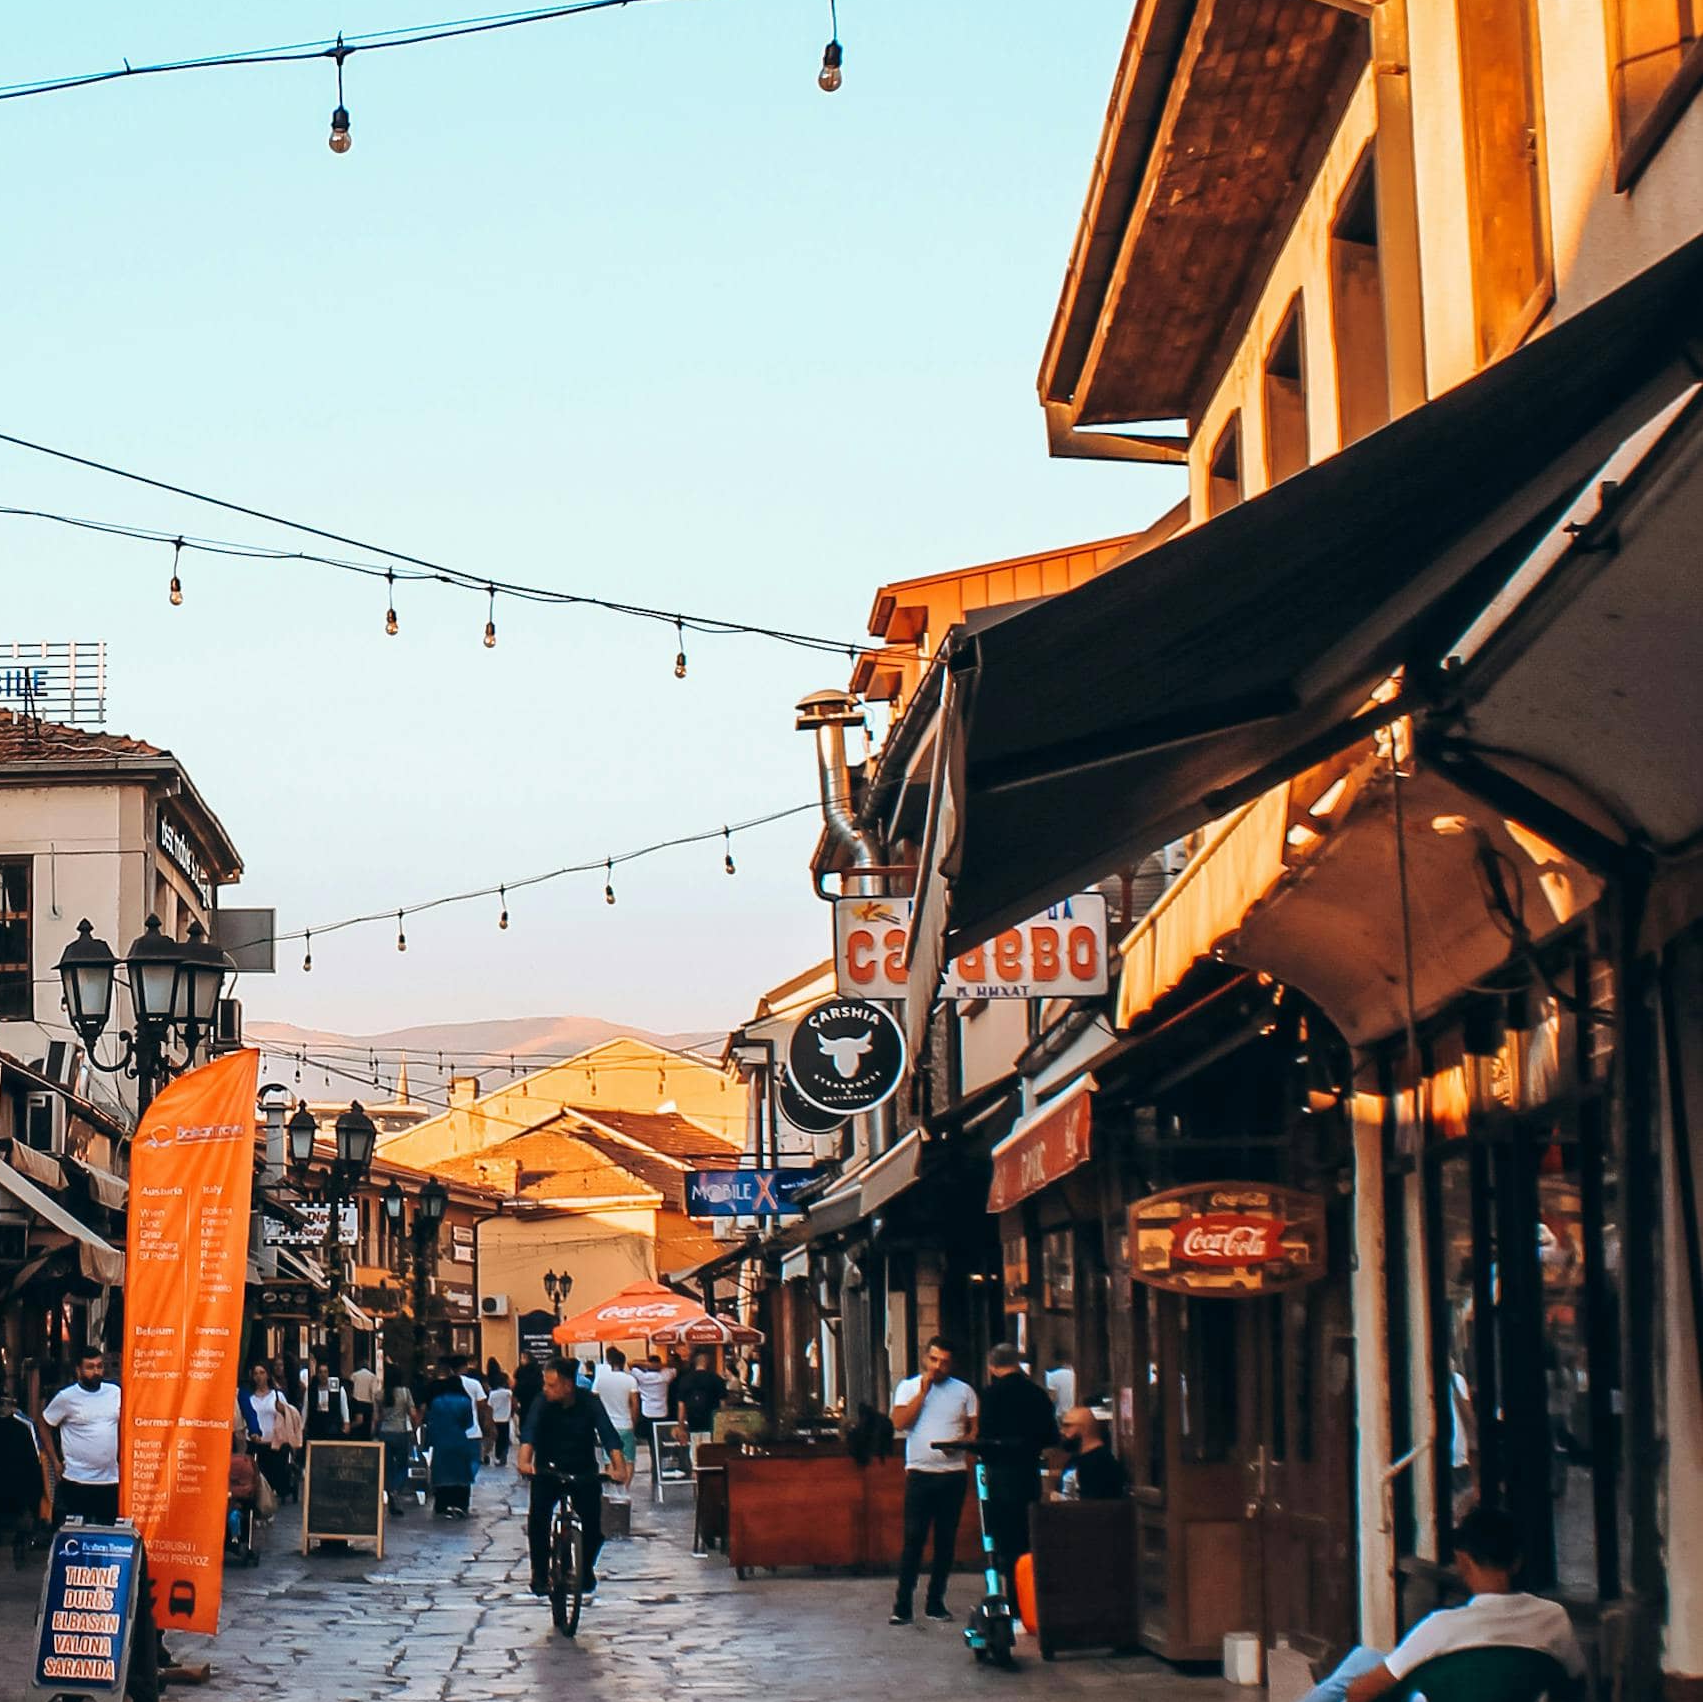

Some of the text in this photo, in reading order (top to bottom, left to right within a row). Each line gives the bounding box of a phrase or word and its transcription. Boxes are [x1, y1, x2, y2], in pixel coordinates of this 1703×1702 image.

[691, 1183, 752, 1203] MOBILE
[135, 1325, 175, 1337] Belgium
[65, 1564, 120, 1588] TIRANË
[63, 1586, 114, 1610] DURËS
[52, 1611, 120, 1634] ELBASAN
[53, 1634, 112, 1657] VALONA
[44, 1656, 115, 1681] SARANDA
